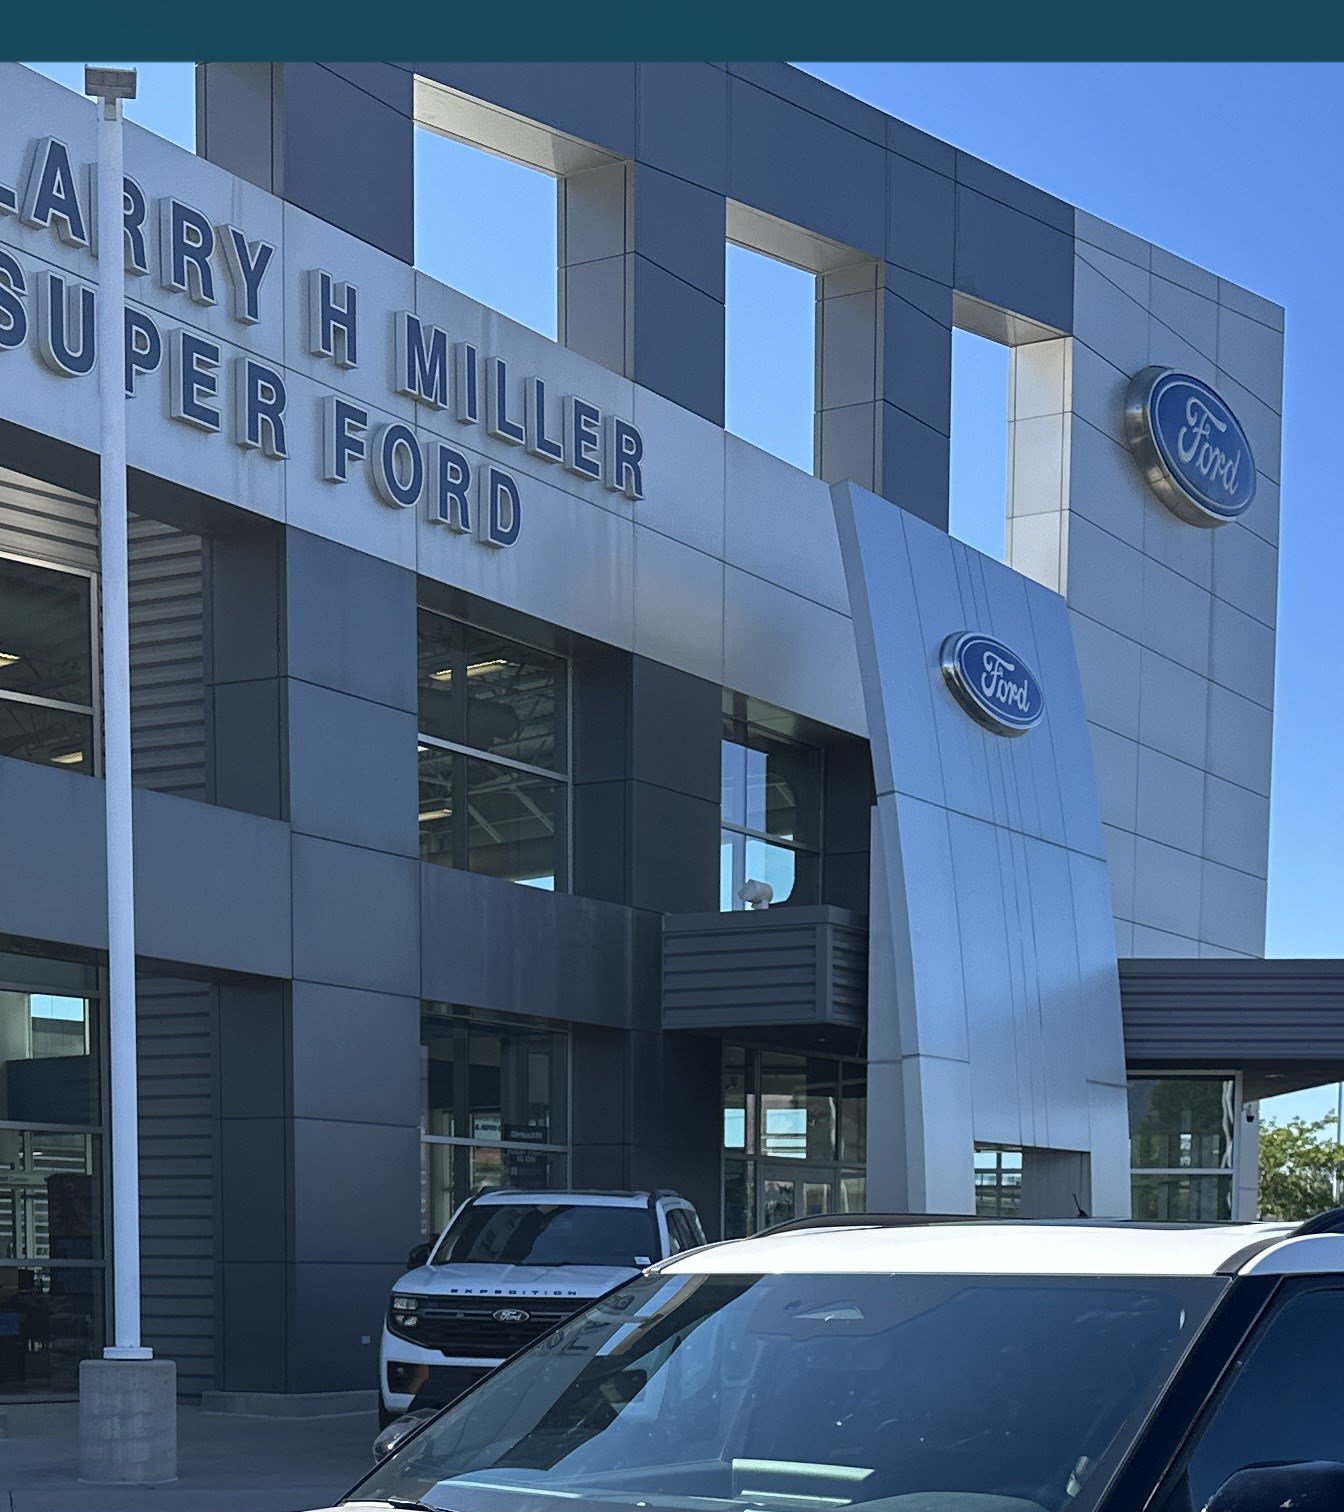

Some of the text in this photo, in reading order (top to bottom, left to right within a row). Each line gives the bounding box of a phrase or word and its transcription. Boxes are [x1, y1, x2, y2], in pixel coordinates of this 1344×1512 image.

[309, 267, 357, 369] H
[395, 309, 645, 500] MILLER
[323, 395, 522, 549] FORD
[1177, 396, 1240, 496] Ford
[981, 650, 1030, 714] Ford
[450, 1288, 577, 1296] EXPEDITION
[500, 1310, 522, 1321] Ford
